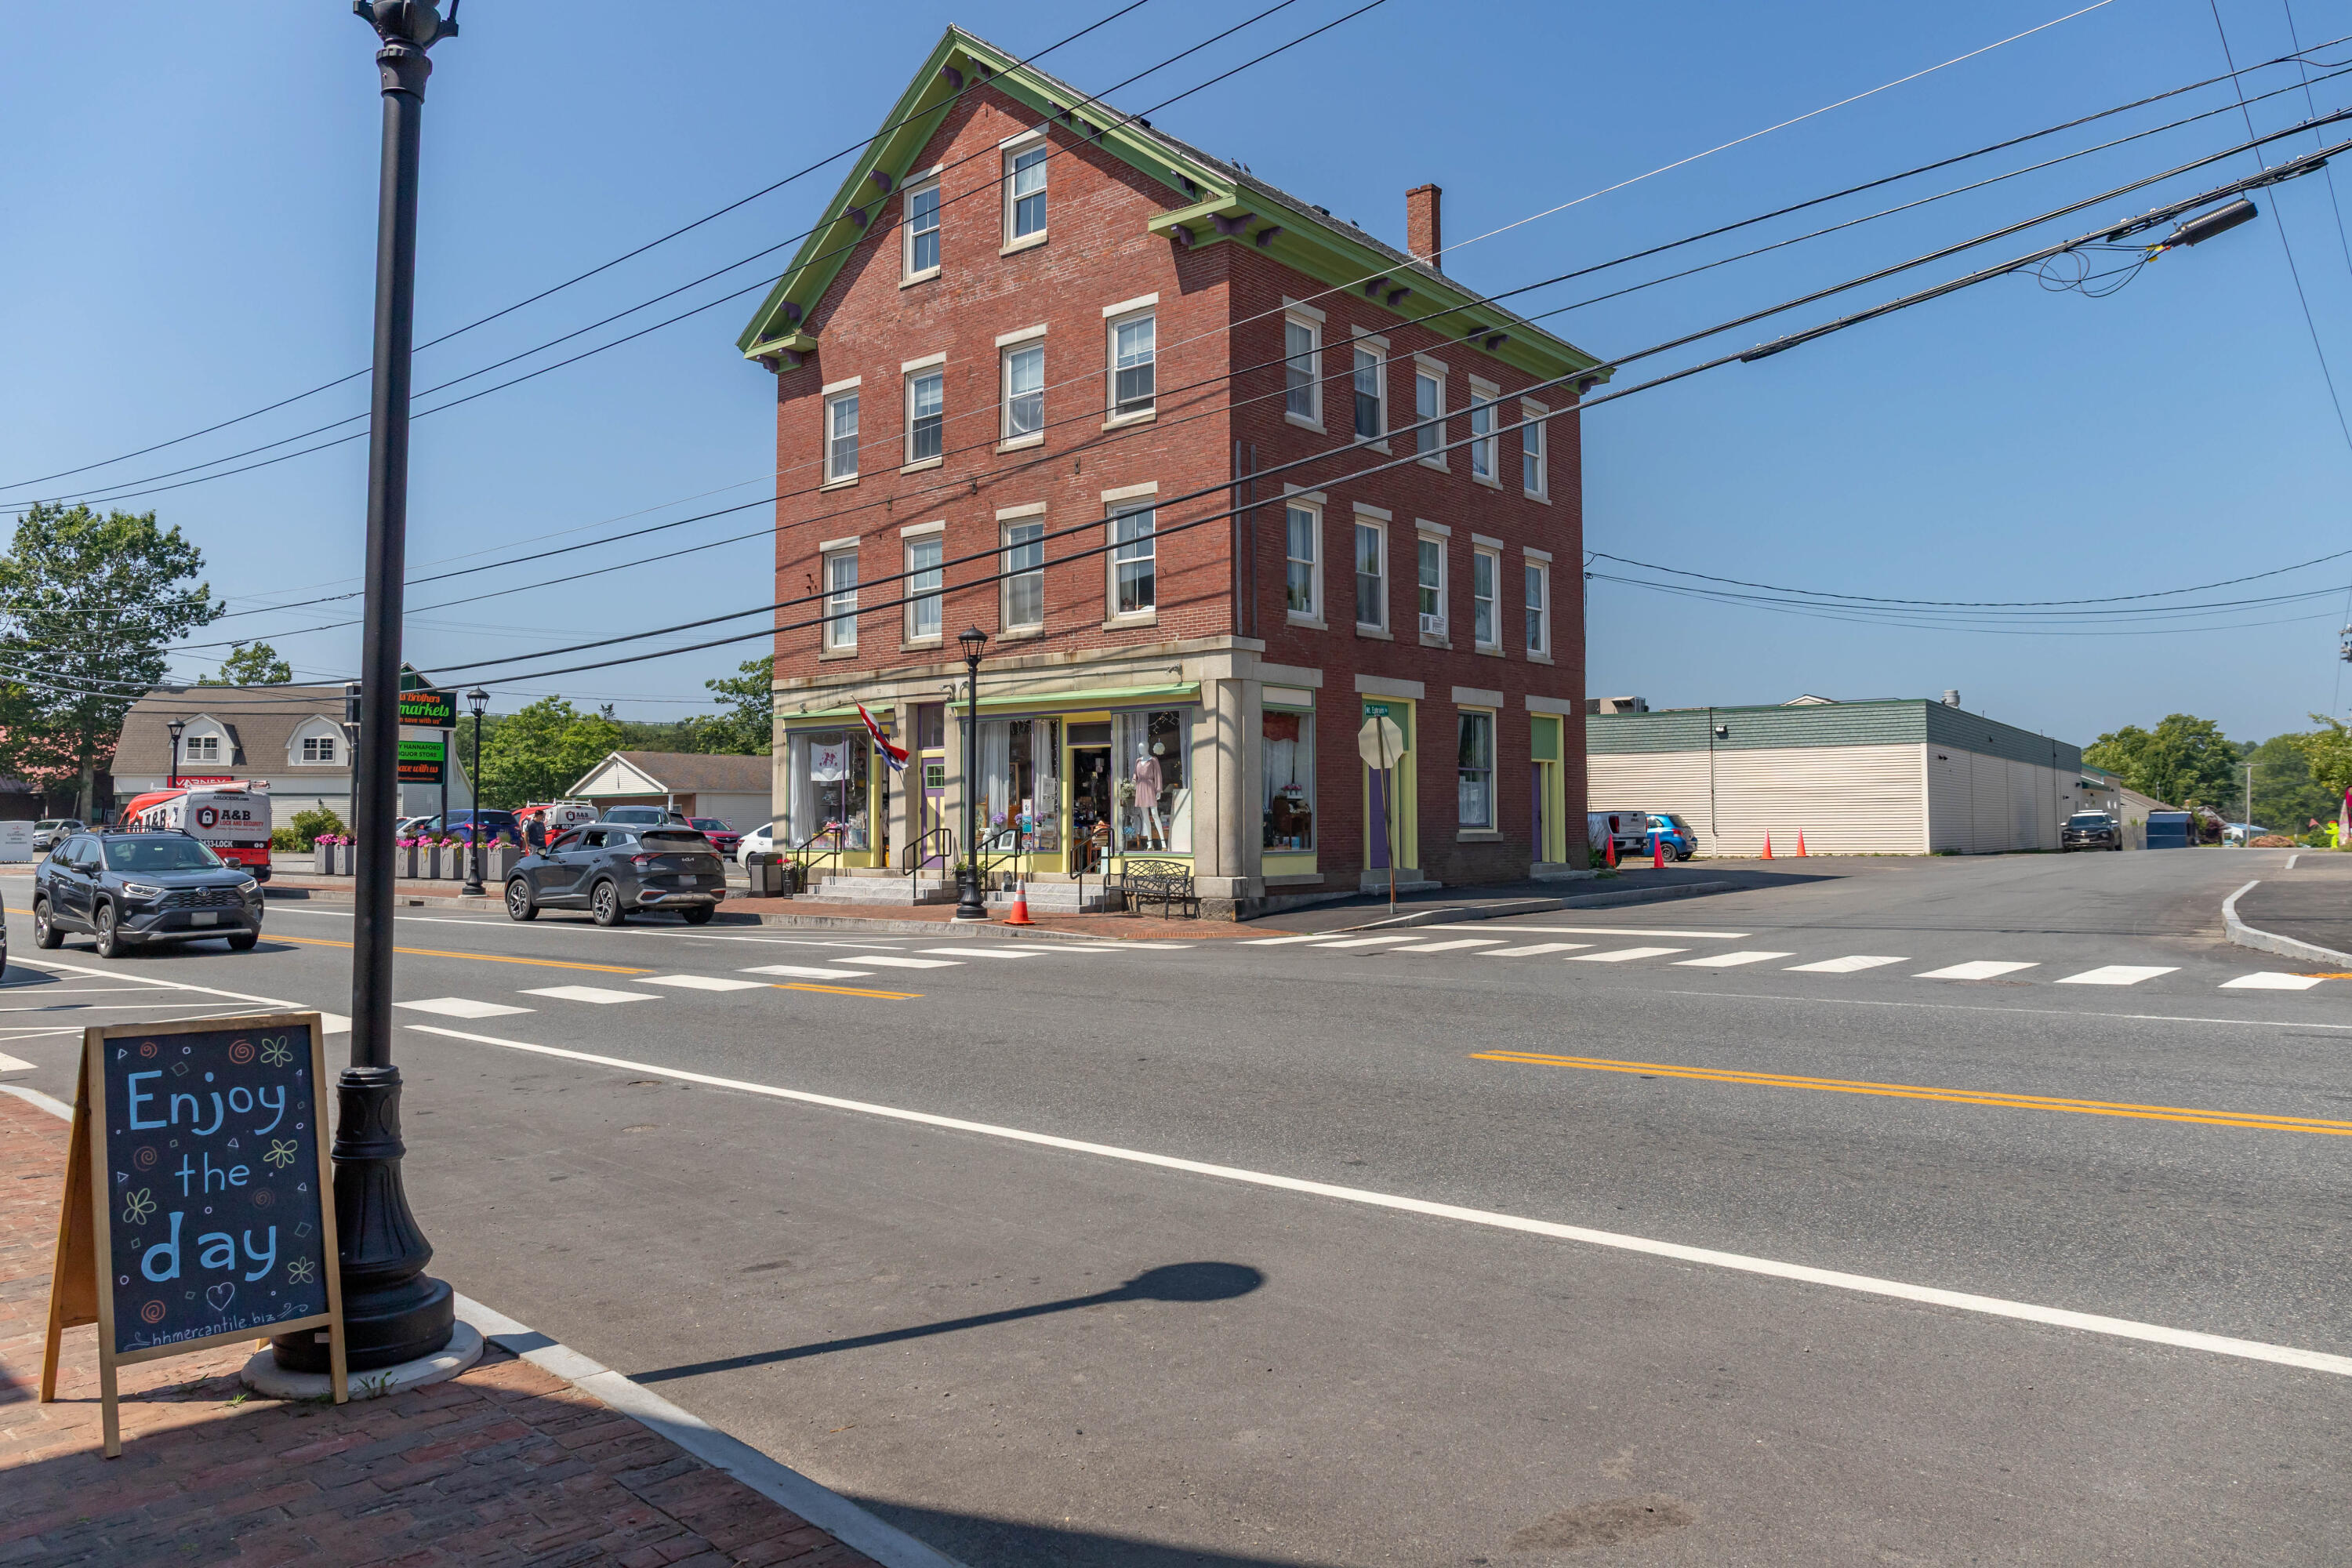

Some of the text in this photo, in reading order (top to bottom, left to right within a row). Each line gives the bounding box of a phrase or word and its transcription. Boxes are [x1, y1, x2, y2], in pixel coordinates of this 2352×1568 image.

[407, 693, 441, 703] Brothers
[220, 810, 251, 820] A&B
[129, 1070, 285, 1135] Enjoy
[175, 1152, 250, 1196] the
[140, 1212, 277, 1283] day
[153, 1312, 276, 1346] hhmercantile.biz
